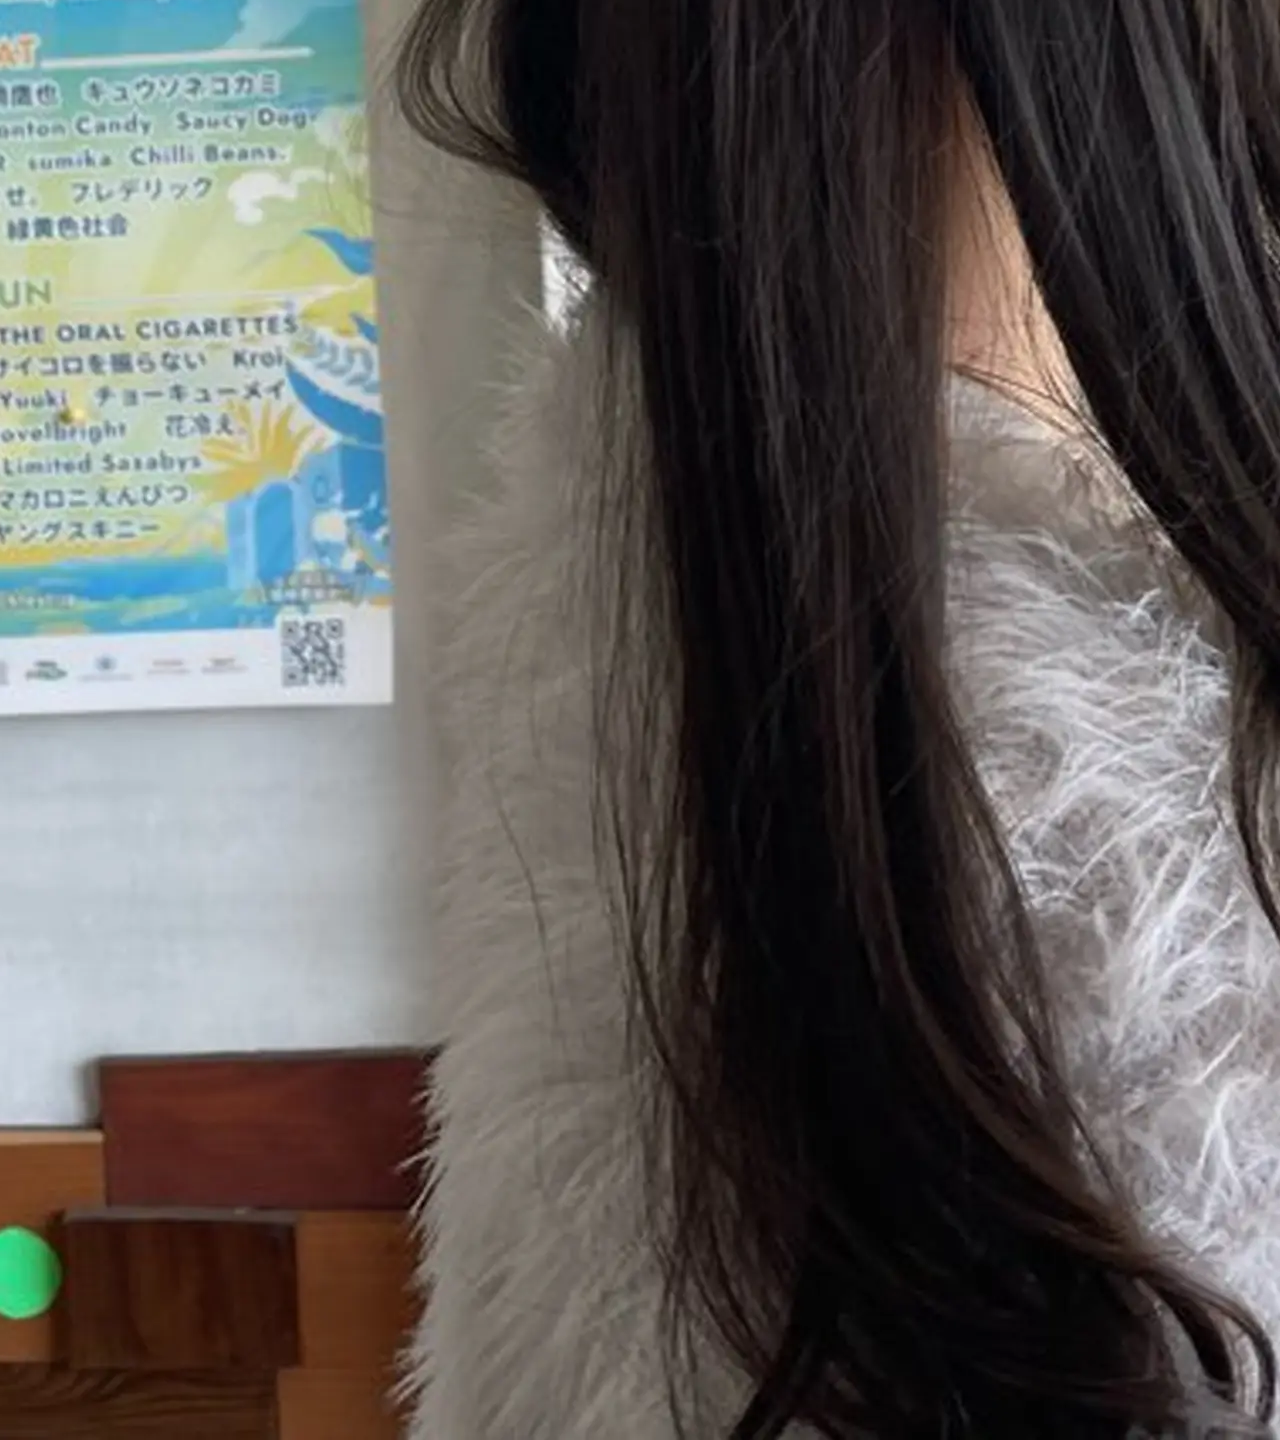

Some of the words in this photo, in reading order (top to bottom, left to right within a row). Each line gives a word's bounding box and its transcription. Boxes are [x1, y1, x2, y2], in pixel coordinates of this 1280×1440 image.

[83, 72, 279, 106] キュウソネコカミ
[74, 109, 152, 136] Candy
[176, 109, 248, 133] Saucy
[28, 150, 112, 173] sumika
[129, 145, 194, 167] Chilli
[71, 178, 212, 205] フレデリック
[55, 321, 126, 345] ORAL
[135, 312, 299, 341] CIGARETTES
[232, 344, 284, 367] Kroi
[0, 388, 67, 410] Yuuki
[94, 380, 286, 408] チョーキューメイ
[2, 452, 93, 476] Limited
[102, 450, 203, 474] Sazabys
